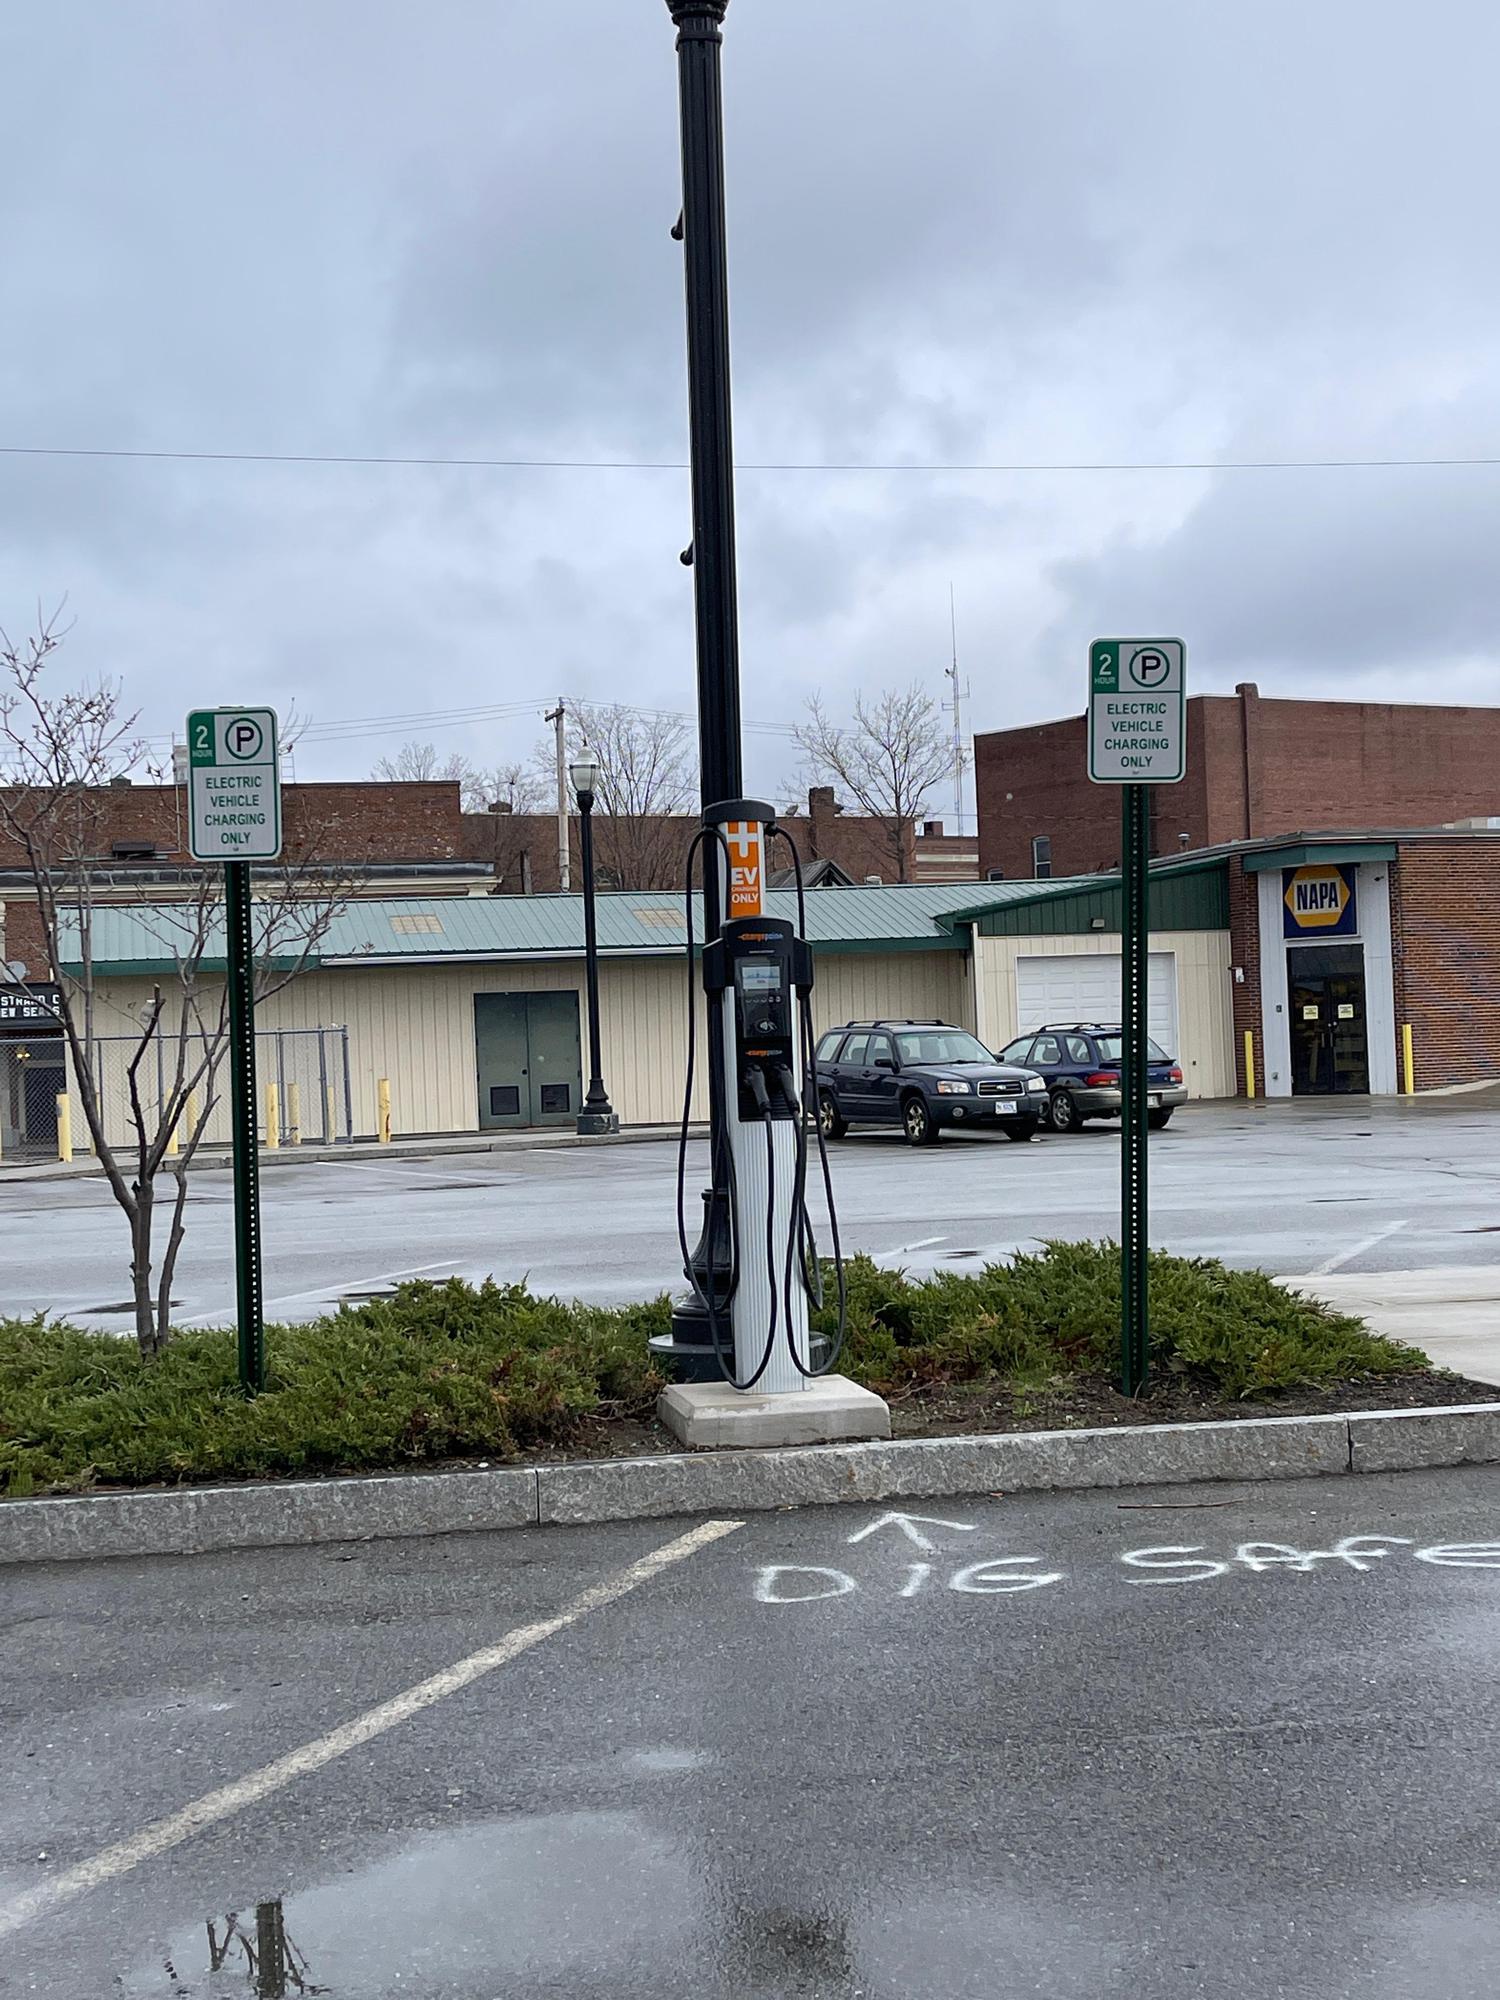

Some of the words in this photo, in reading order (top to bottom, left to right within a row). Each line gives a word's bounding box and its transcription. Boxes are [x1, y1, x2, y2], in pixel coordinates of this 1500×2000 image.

[1099, 653, 1112, 676] 2
[1141, 655, 1161, 680] P
[1094, 677, 1115, 685] HOUR
[1107, 703, 1167, 715] ELECTRIC
[1111, 721, 1163, 732] VEHICLE
[195, 725, 208, 748] 2
[236, 726, 255, 752] P
[1104, 739, 1169, 750] CHARGING
[1121, 756, 1152, 768] ONLY
[206, 776, 262, 789] ELECTRIC
[211, 795, 259, 807] VEHICLE
[204, 813, 265, 826] CHARGING
[220, 833, 250, 844] ONLY
[731, 866, 758, 885] EV
[731, 893, 759, 904] ONLY
[1296, 882, 1339, 911] NAPA
[754, 1555, 1064, 1603] DIG
[1120, 1534, 1500, 1584] SAFE
